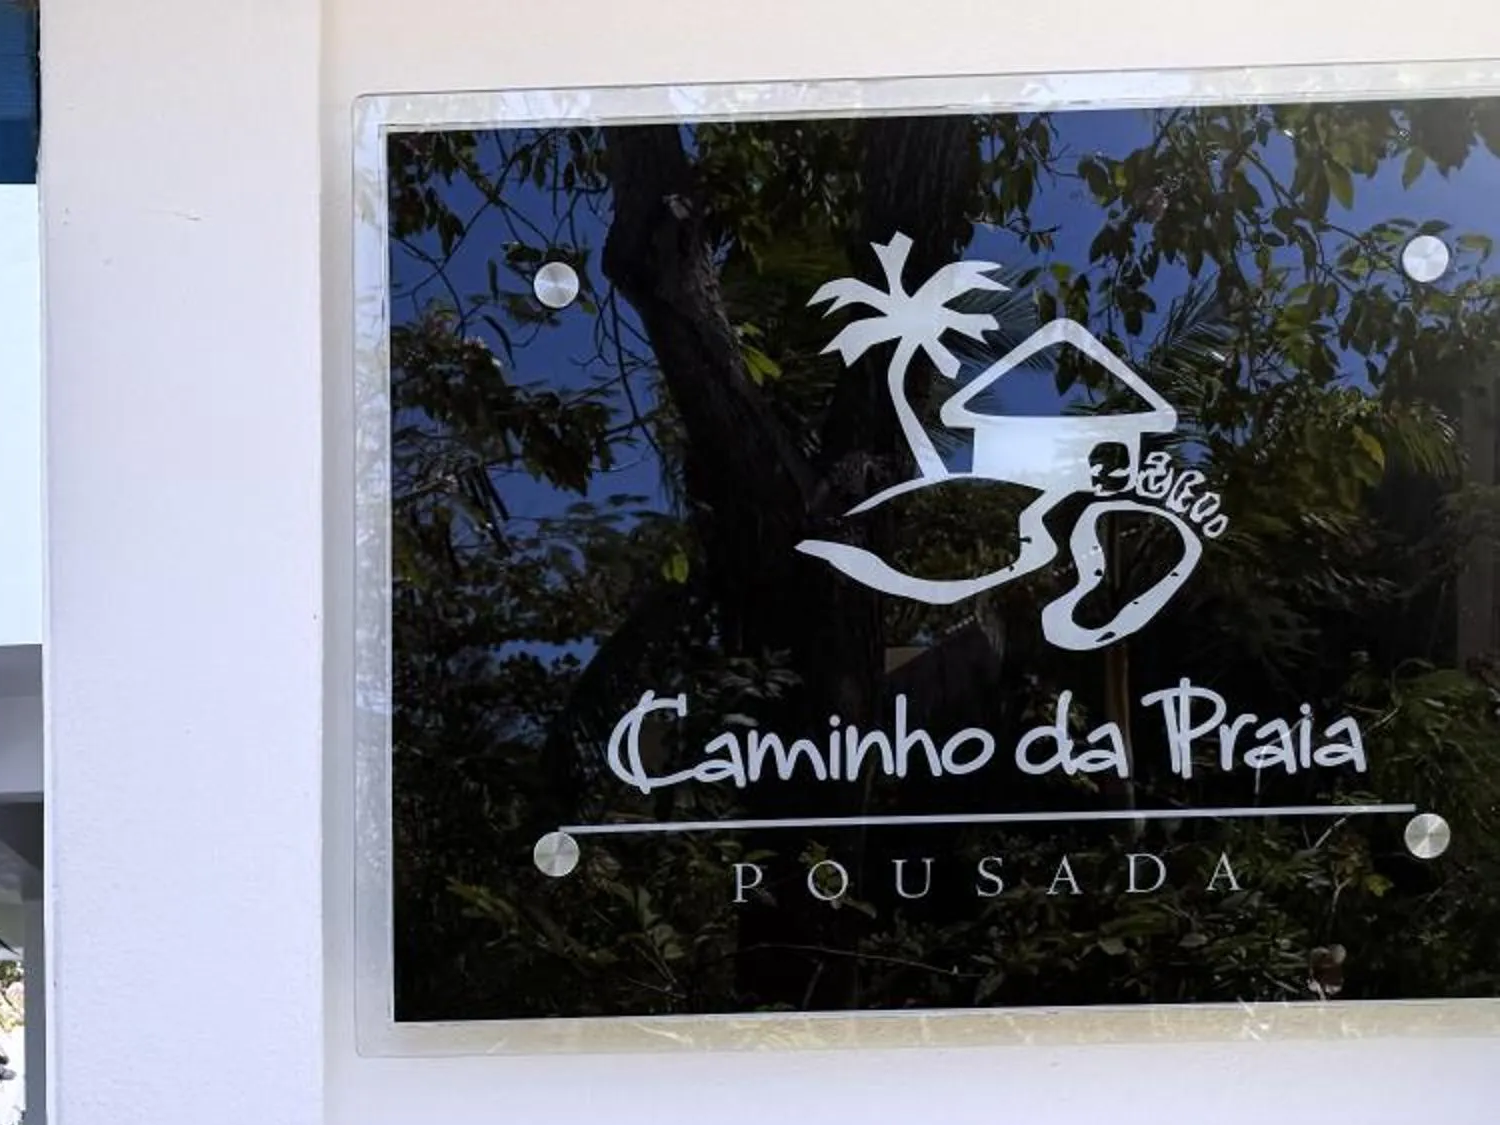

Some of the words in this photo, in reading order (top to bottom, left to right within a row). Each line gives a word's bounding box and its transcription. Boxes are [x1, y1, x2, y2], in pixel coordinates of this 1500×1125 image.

[606, 689, 996, 795] Caminho
[1015, 689, 1130, 778] da
[1140, 676, 1368, 780] Praia
[732, 852, 1245, 904] POUSADA
